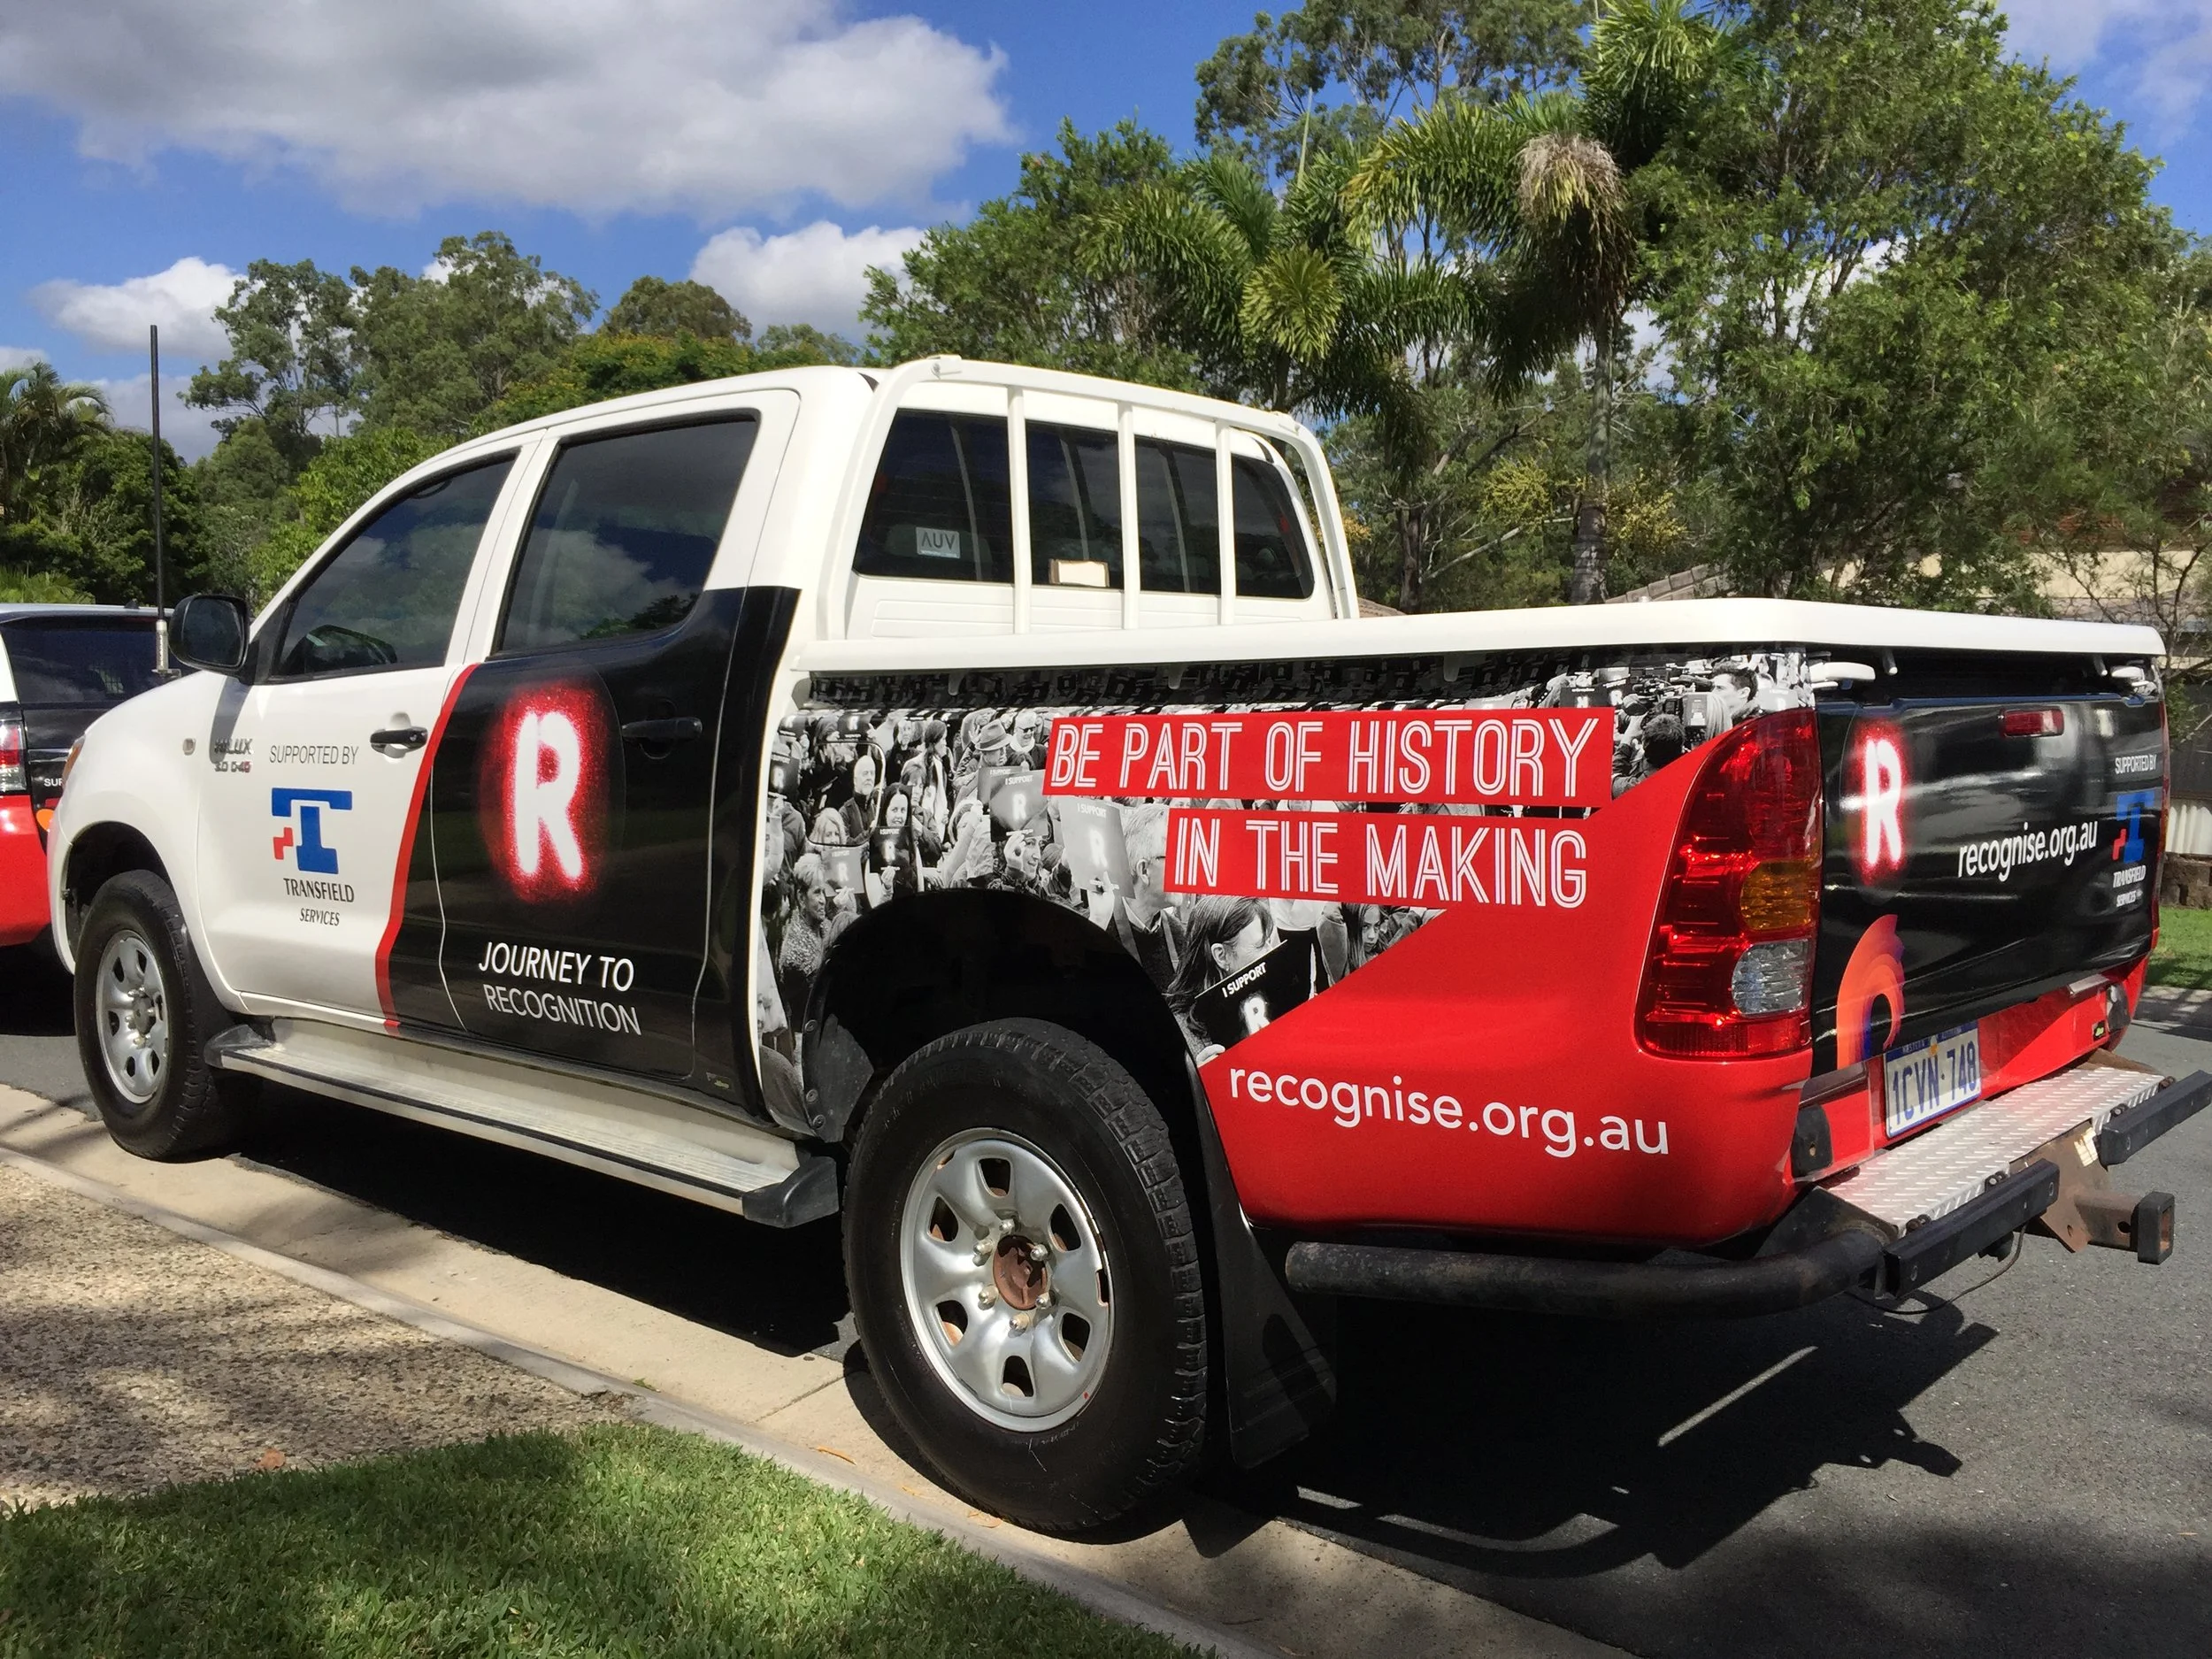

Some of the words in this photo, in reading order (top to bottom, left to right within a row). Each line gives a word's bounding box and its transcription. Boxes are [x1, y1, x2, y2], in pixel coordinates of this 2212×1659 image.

[269, 744, 340, 764] SUPPORTED
[342, 748, 359, 766] BY
[1050, 723, 1104, 787] BE
[1119, 721, 1242, 791] PART
[1264, 720, 1324, 793] OF
[1348, 718, 1600, 796] HISTORY
[2115, 755, 2148, 774] SUPPORTED
[2149, 754, 2157, 771] BY
[515, 709, 584, 880] R
[1864, 739, 1902, 866] R
[1175, 817, 1220, 886] IN
[1246, 819, 1339, 895] THE
[1365, 823, 1587, 909] MAKING
[1957, 819, 2098, 882] recognise.org.au
[2112, 864, 2147, 888] TRANSFIELD
[282, 878, 355, 903] TRANSFIELD
[299, 908, 341, 927] SERVICES
[478, 941, 596, 986] JOURNEY
[599, 955, 635, 992] TO
[1221, 987, 1228, 998] I
[1226, 962, 1267, 995] SUPPORT
[482, 983, 642, 1036] RECOGNITION
[1229, 1065, 1671, 1159] recognise.org.au
